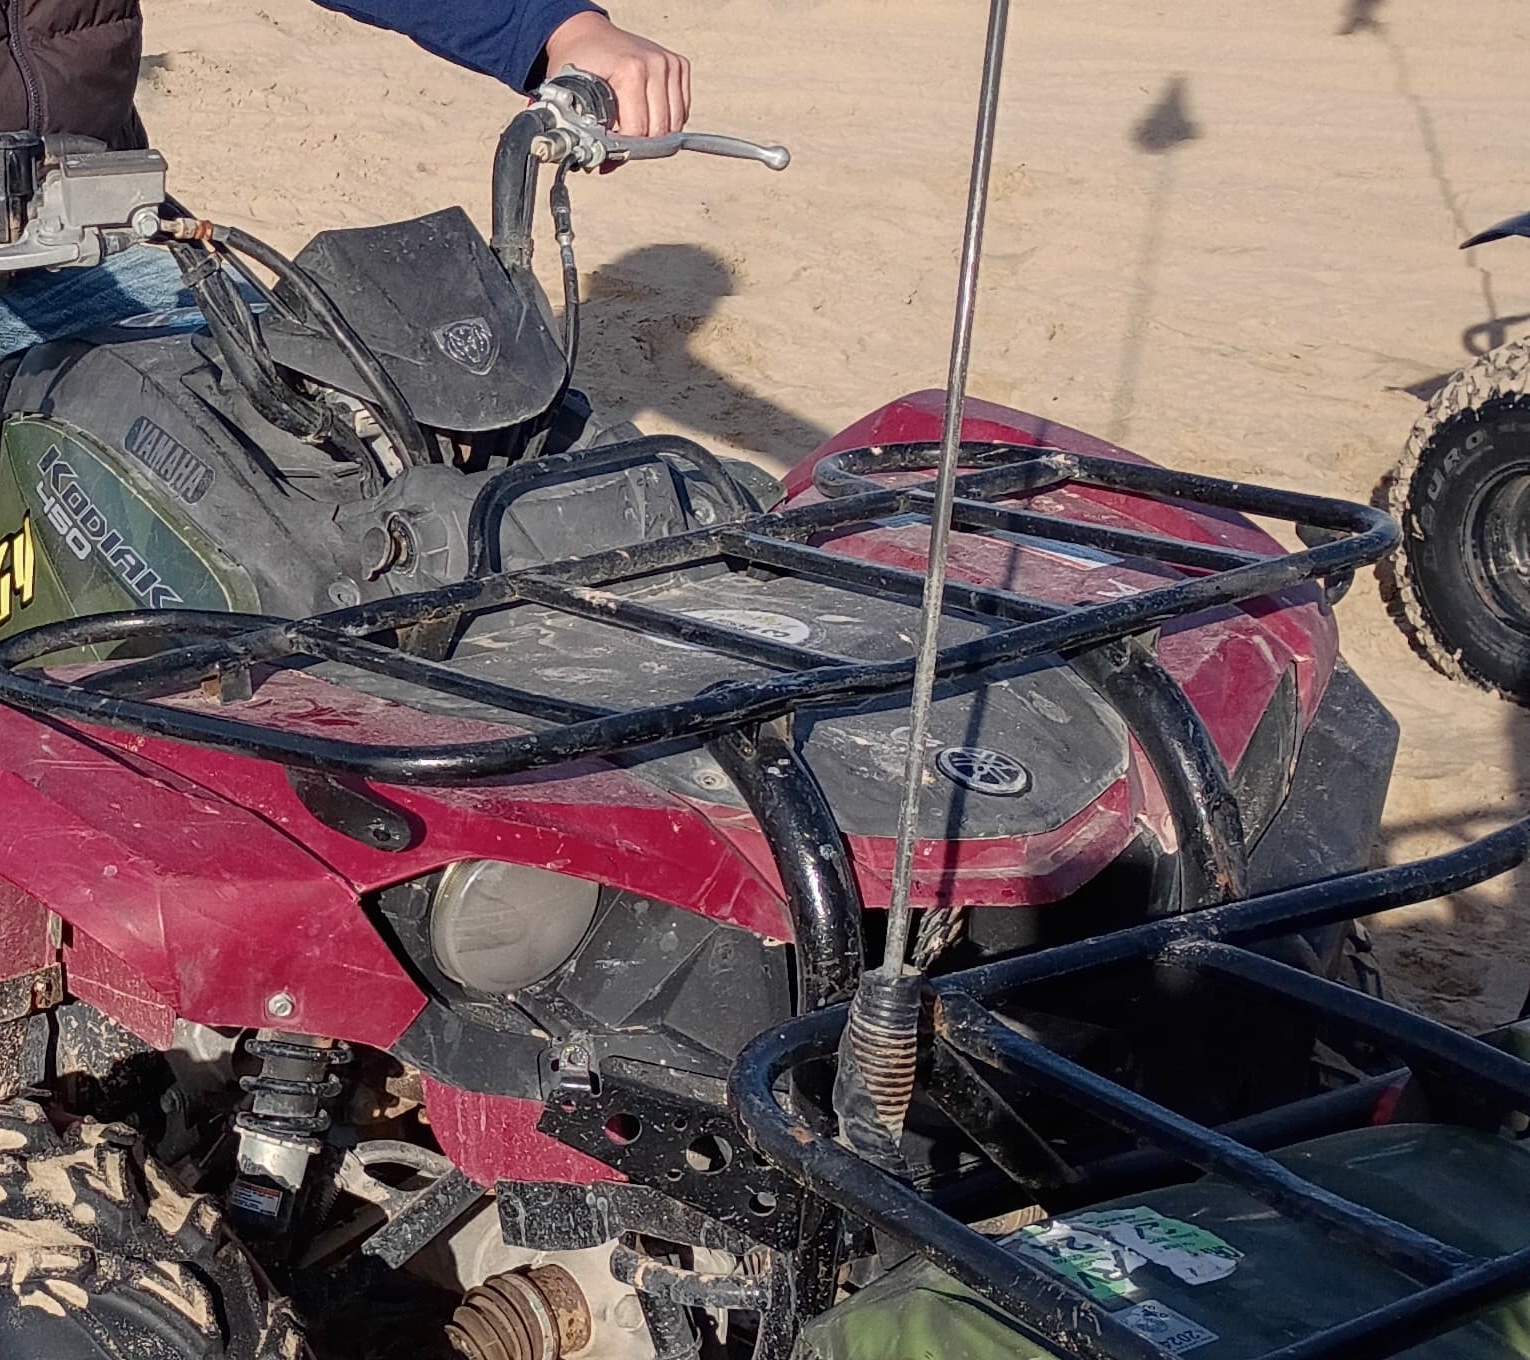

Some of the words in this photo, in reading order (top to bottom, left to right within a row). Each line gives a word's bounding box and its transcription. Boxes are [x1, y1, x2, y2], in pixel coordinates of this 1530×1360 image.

[131, 418, 208, 500] YAMAHA
[36, 480, 93, 561] 450
[37, 443, 184, 608] KODIAK
